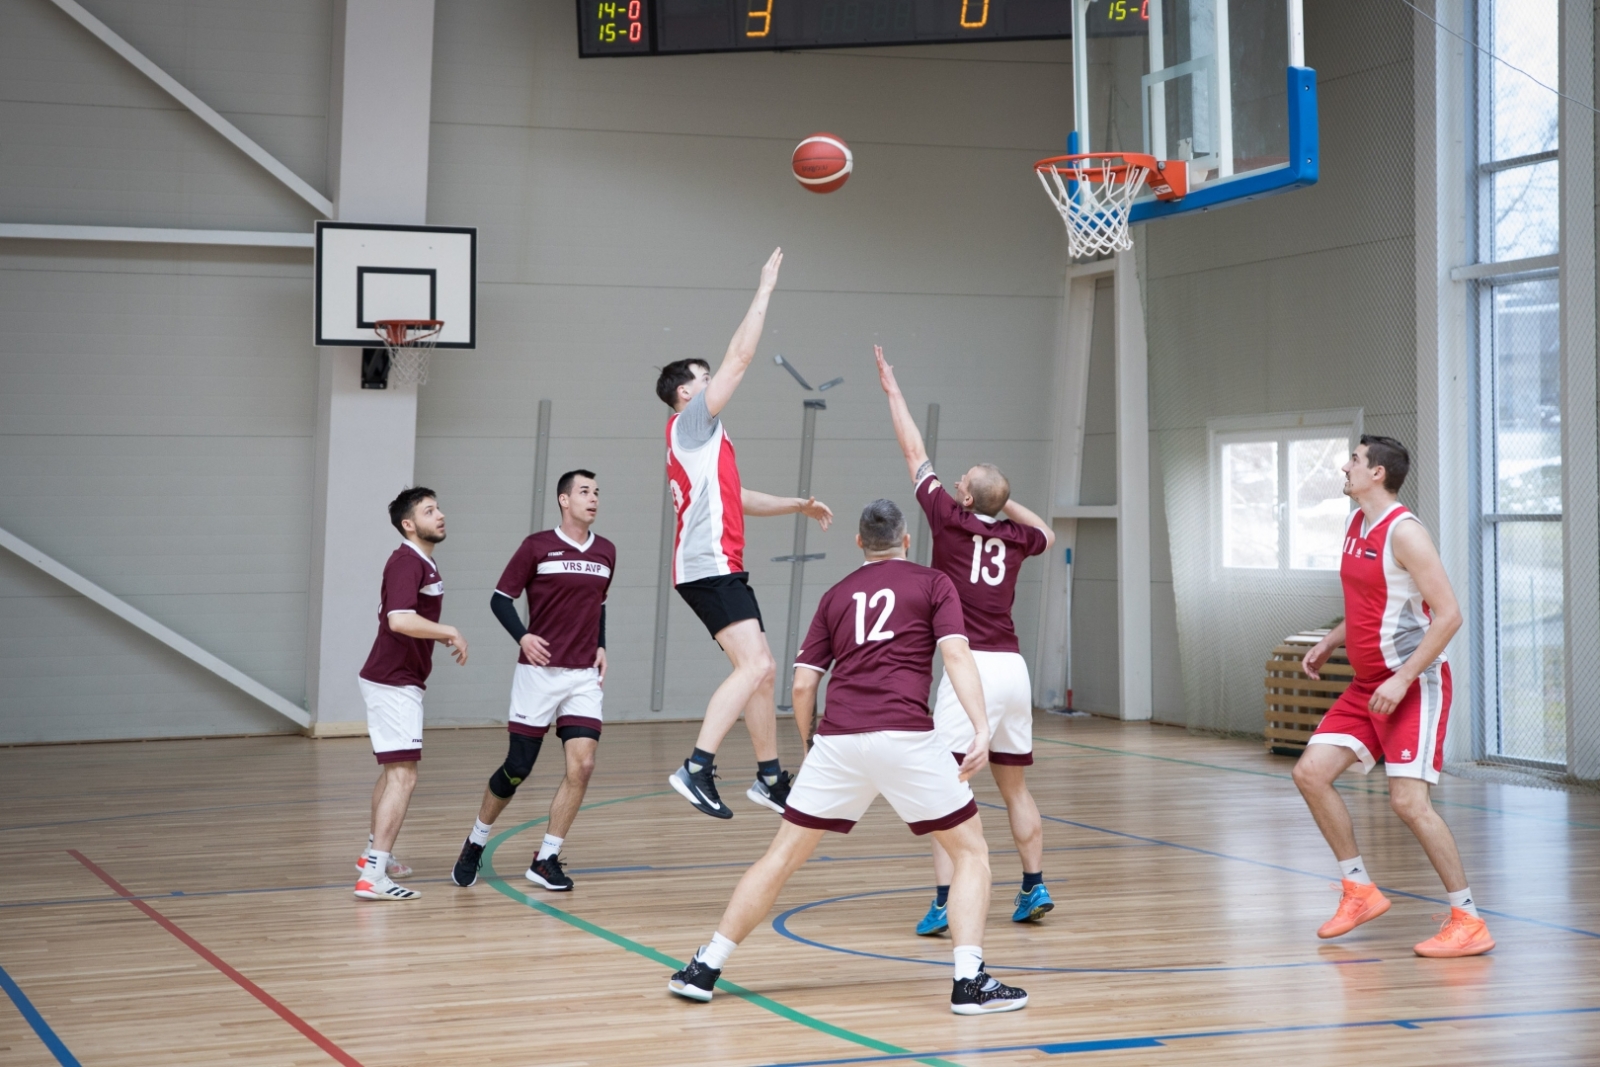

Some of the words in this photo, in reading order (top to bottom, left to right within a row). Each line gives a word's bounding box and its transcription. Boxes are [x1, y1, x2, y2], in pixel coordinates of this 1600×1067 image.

[970, 535, 1006, 586] 13
[1343, 536, 1357, 555] 11
[562, 562, 582, 571] VRS
[852, 588, 895, 645] 12
